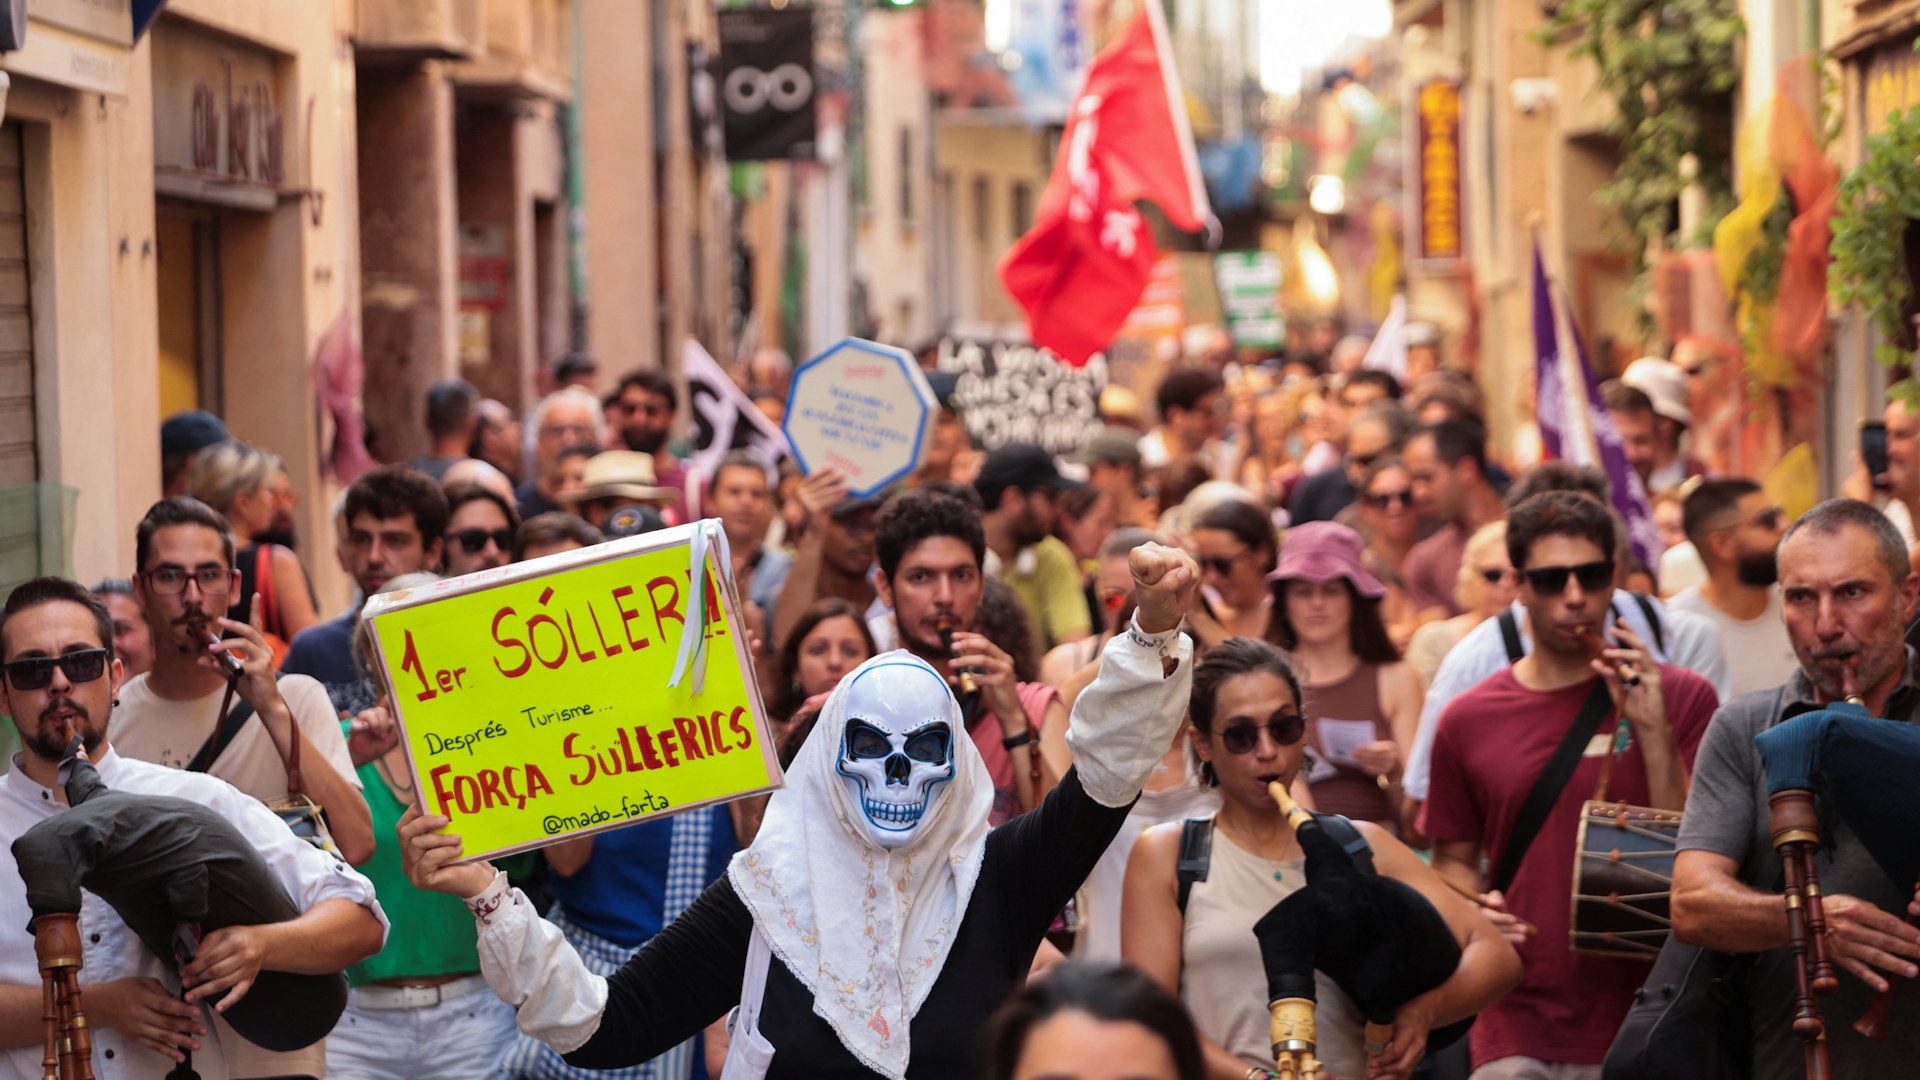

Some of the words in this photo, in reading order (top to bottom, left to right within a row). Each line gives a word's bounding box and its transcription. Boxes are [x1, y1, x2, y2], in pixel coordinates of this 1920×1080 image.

[424, 720, 507, 756] Després
[430, 763, 555, 822] FORÇA
[543, 790, 669, 834] @mado_farta
